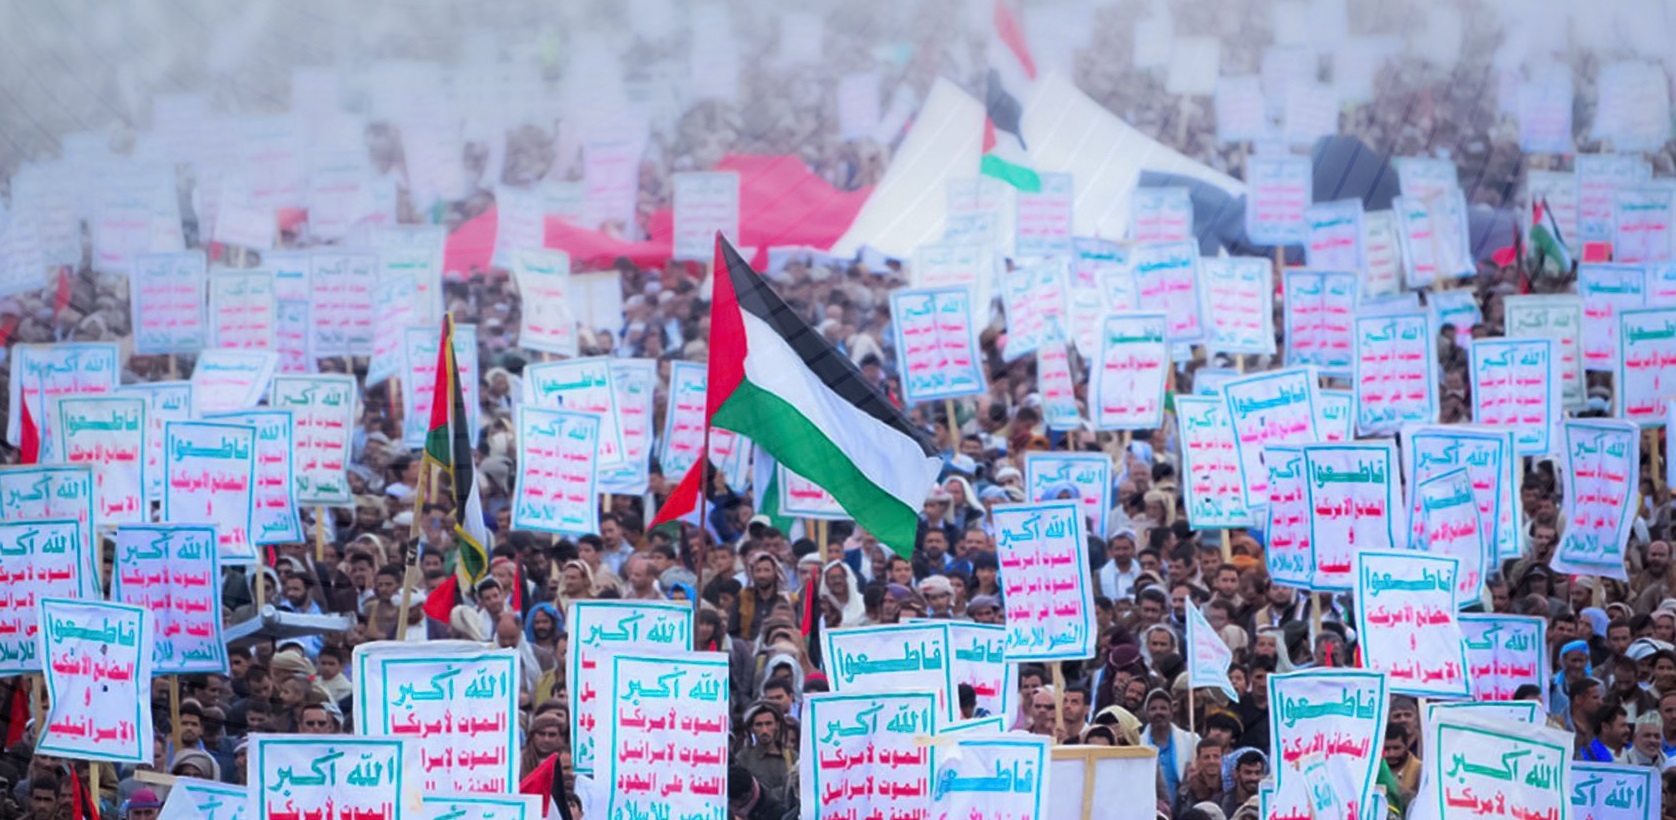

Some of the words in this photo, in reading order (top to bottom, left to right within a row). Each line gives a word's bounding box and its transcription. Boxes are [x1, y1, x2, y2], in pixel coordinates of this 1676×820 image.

[65, 408, 139, 437] قاطعوا
[171, 433, 249, 462] قاطعوا
[57, 475, 87, 500] الله
[1311, 458, 1385, 488] قاطعوا
[7, 473, 53, 510] أكبر
[42, 529, 75, 554] الله
[999, 510, 1042, 550] أكبر
[1045, 513, 1074, 540] الله
[120, 531, 174, 567] أكبر
[177, 534, 210, 560] الله
[1366, 565, 1452, 597] قاطعوا
[47, 611, 136, 647] قاطعوا
[581, 610, 645, 648] أكبر
[646, 615, 686, 644] الله
[1505, 627, 1536, 651] الله
[836, 640, 943, 684] قاطعوا
[955, 636, 1004, 664] قاط
[84, 686, 91, 707] و
[391, 664, 462, 710] أكبر
[464, 667, 507, 699] الله
[620, 665, 688, 706] أكبر
[688, 671, 728, 703] الله
[886, 702, 929, 735] الله
[1278, 687, 1377, 729] قاطعوا
[457, 711, 507, 738] الموت
[680, 713, 728, 737] الموت
[819, 700, 886, 748] أكبر
[267, 746, 345, 798] أكبر
[346, 751, 395, 788] الله
[457, 745, 507, 771] الموت
[679, 745, 727, 768] الموت
[878, 745, 929, 770] الموت
[1445, 742, 1532, 785] أكبر
[617, 771, 657, 796] اليهود
[689, 773, 726, 796] اللعنة
[878, 776, 928, 801] الموت
[1525, 754, 1559, 793] الله
[1571, 773, 1604, 807] أك
[1604, 779, 1644, 811] الله
[340, 801, 393, 820] الموت
